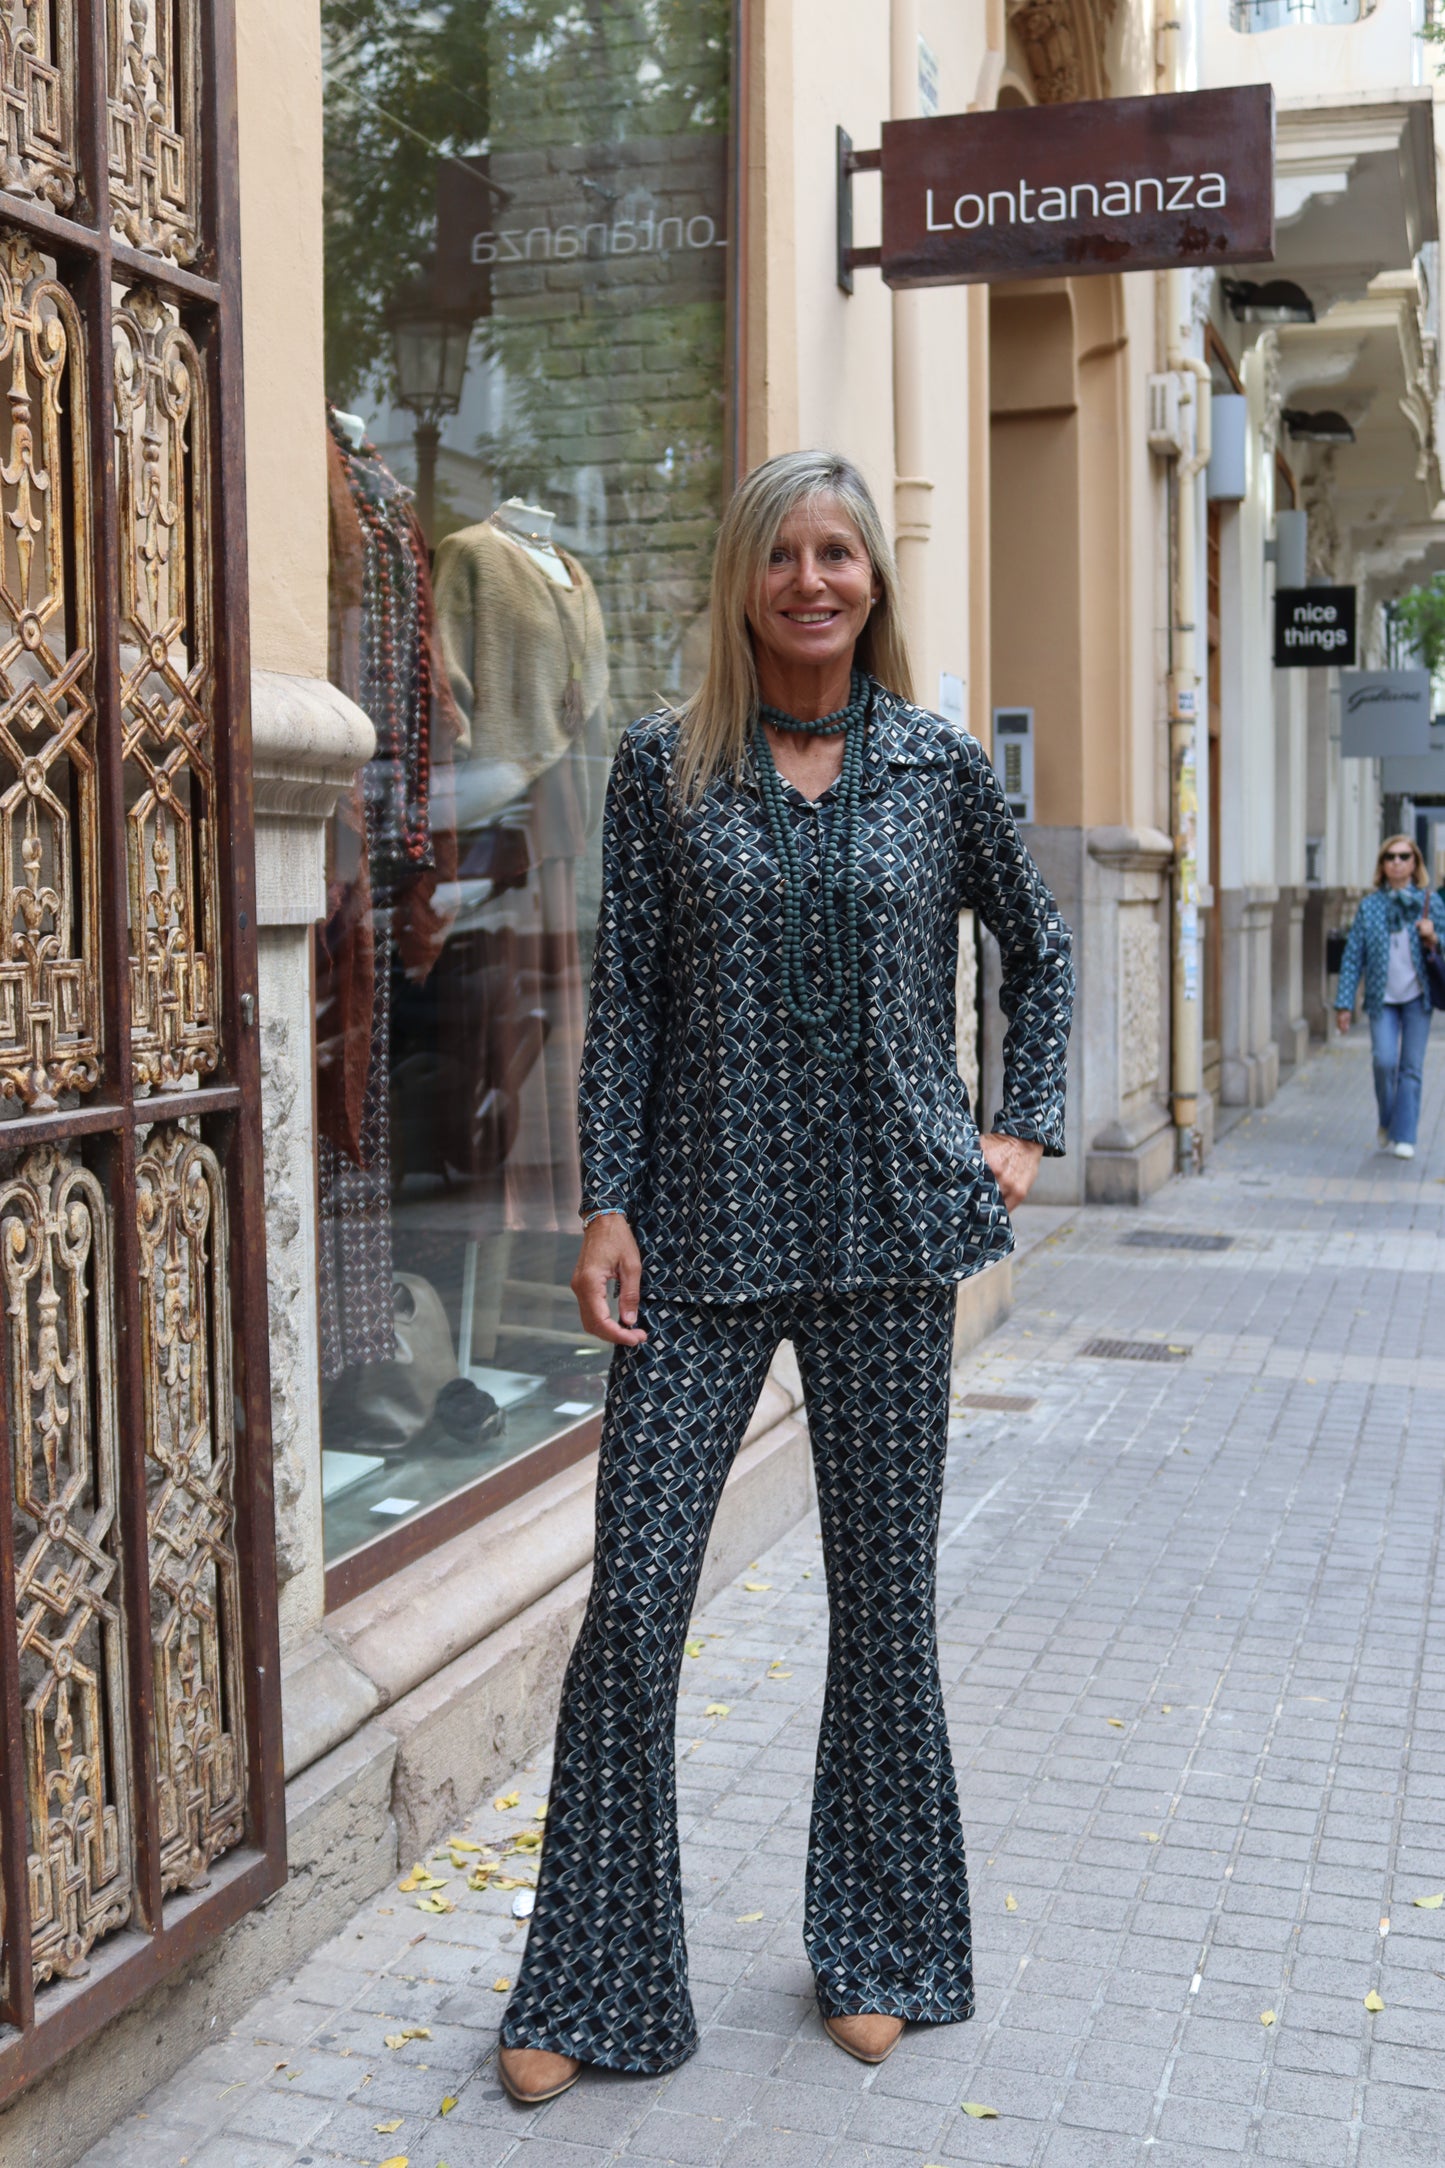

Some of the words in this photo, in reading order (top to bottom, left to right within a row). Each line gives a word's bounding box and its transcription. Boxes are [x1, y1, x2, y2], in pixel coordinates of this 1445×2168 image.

[926, 172, 1226, 231] Lontananza
[1293, 602, 1337, 623] nice
[1284, 625, 1348, 651] things
